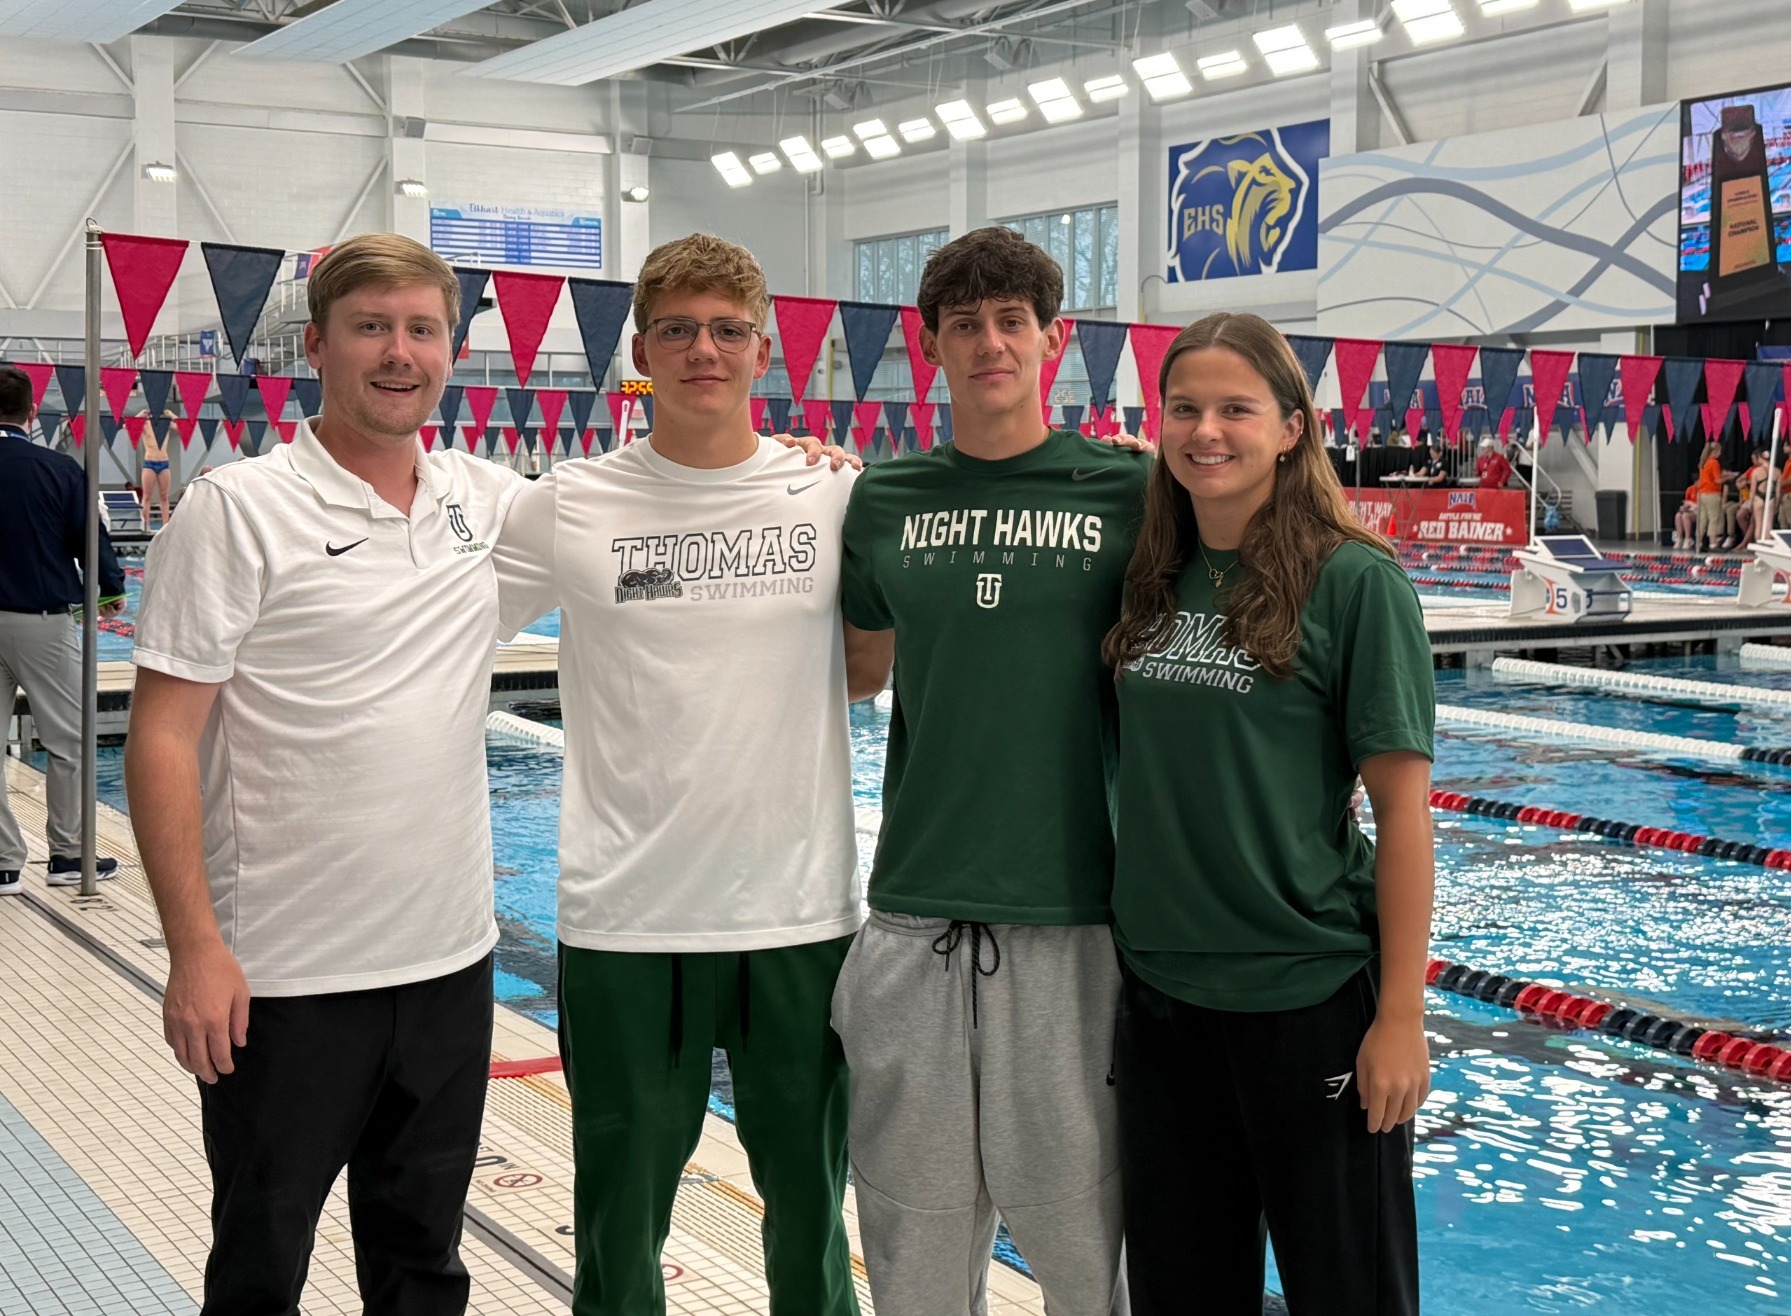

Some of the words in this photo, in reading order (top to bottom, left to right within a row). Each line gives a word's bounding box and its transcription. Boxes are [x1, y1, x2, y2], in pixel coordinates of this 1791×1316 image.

[1183, 204, 1225, 241] EHS
[900, 509, 988, 551] NIGHT
[993, 509, 1102, 552] HAWKS
[1418, 521, 1446, 539] RED
[611, 523, 817, 581] THOMAS
[690, 577, 814, 601] SWIMMING
[1556, 588, 1567, 609] 5
[1142, 661, 1255, 694] SWIMMING
